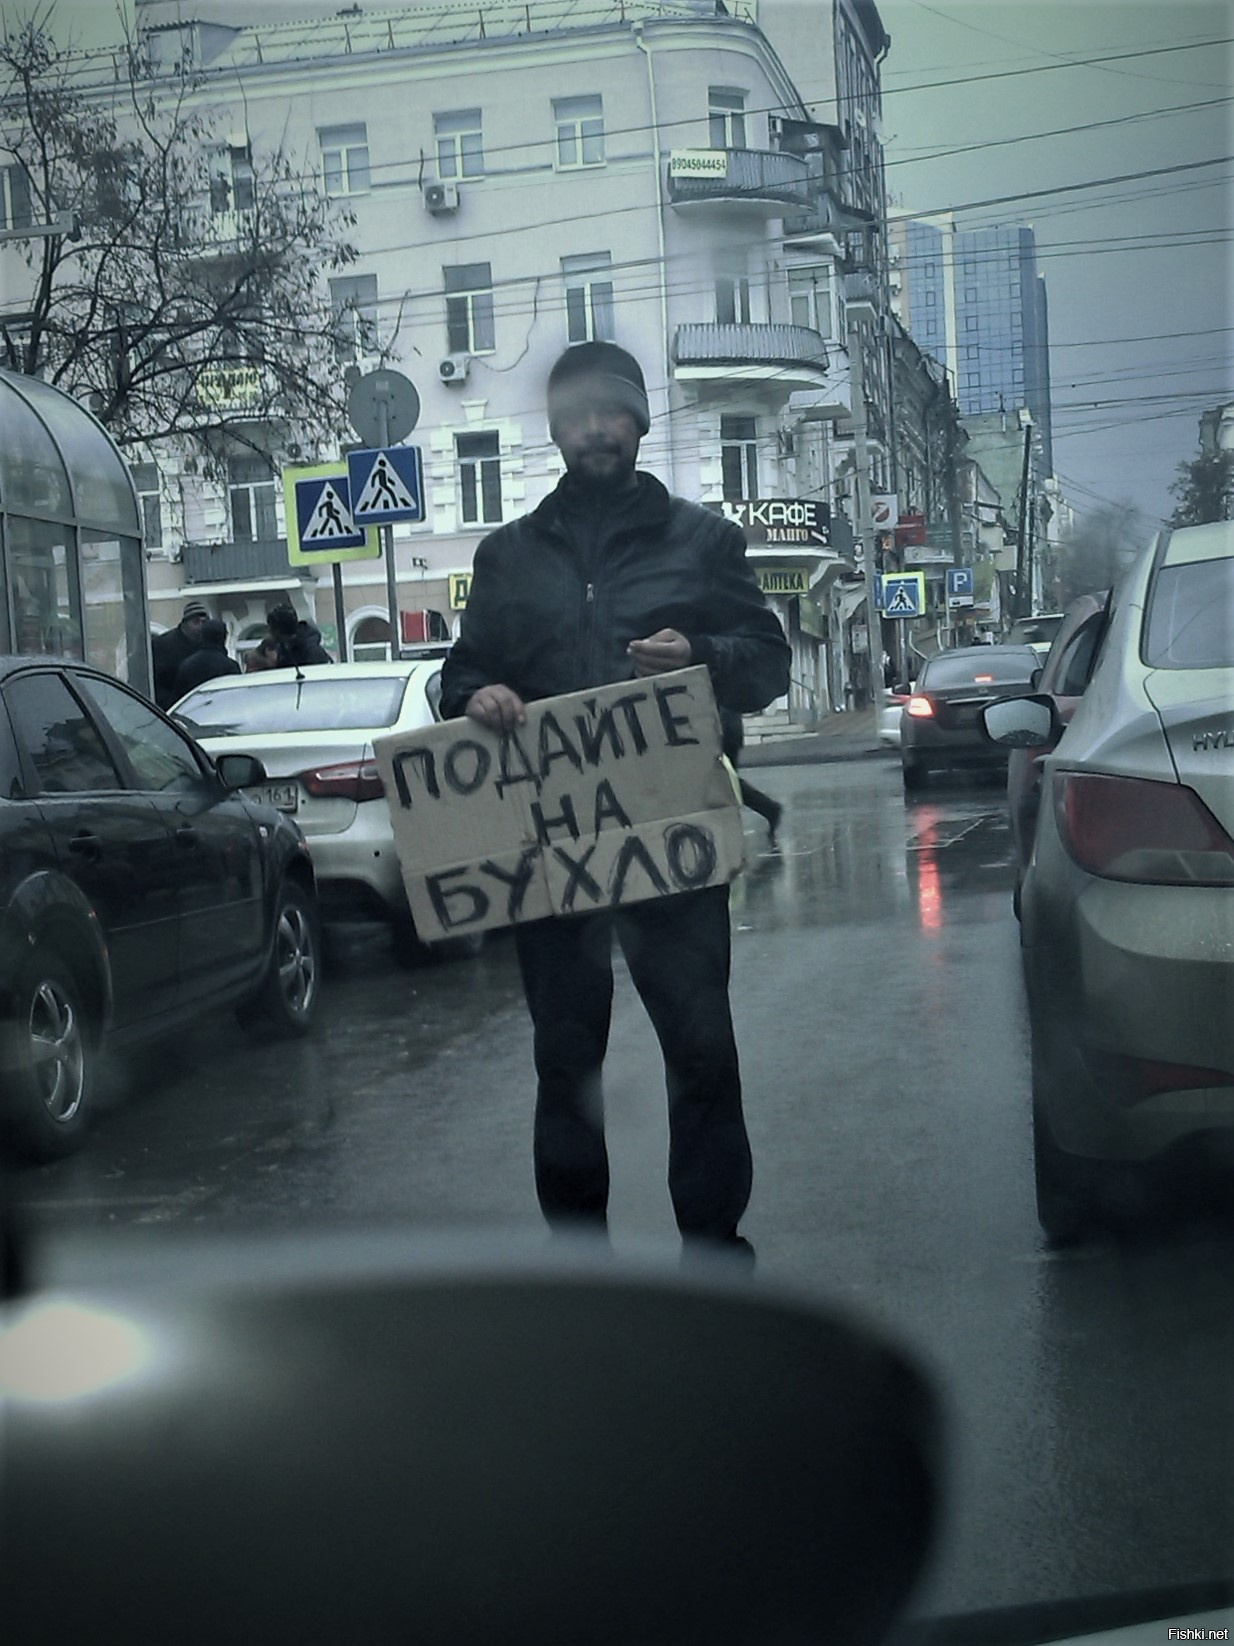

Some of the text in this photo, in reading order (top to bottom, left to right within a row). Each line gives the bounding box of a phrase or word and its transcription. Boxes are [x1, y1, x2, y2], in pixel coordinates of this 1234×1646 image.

[748, 502, 816, 526] КАФЕ
[762, 573, 805, 591] АПТЕКА
[953, 572, 968, 592] P
[392, 682, 700, 810] ПОДАЙТЕ
[530, 778, 633, 847] НА
[425, 822, 718, 932] БУХЛО
